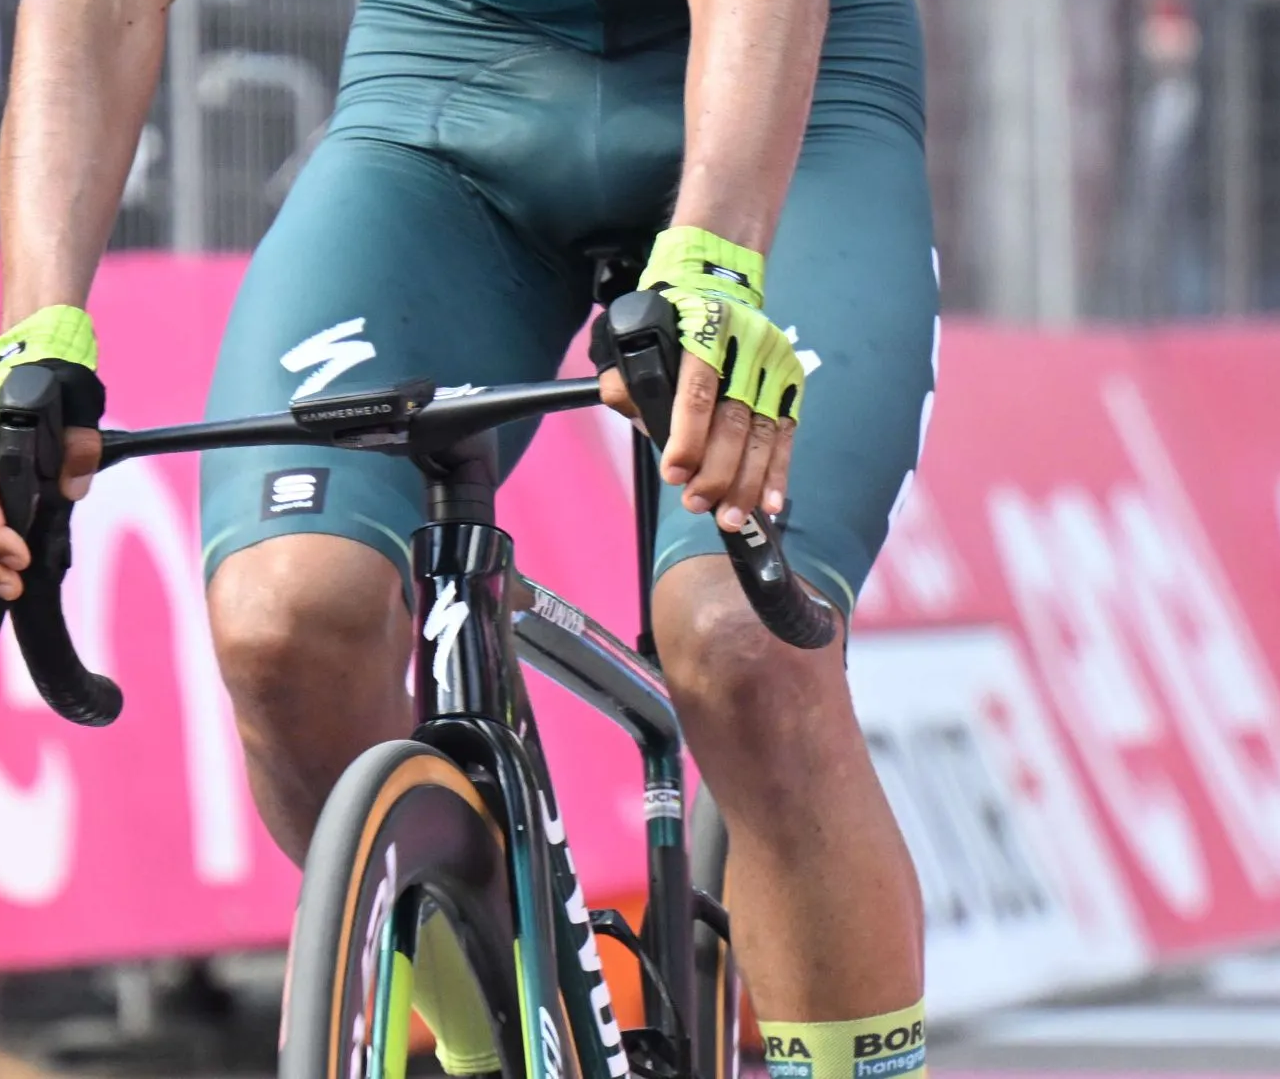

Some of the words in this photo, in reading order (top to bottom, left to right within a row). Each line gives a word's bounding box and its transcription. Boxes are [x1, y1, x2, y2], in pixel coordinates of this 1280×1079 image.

[299, 403, 393, 422] HAMMERHEAD
[766, 1036, 812, 1059] RA
[854, 1020, 923, 1058] BOR
